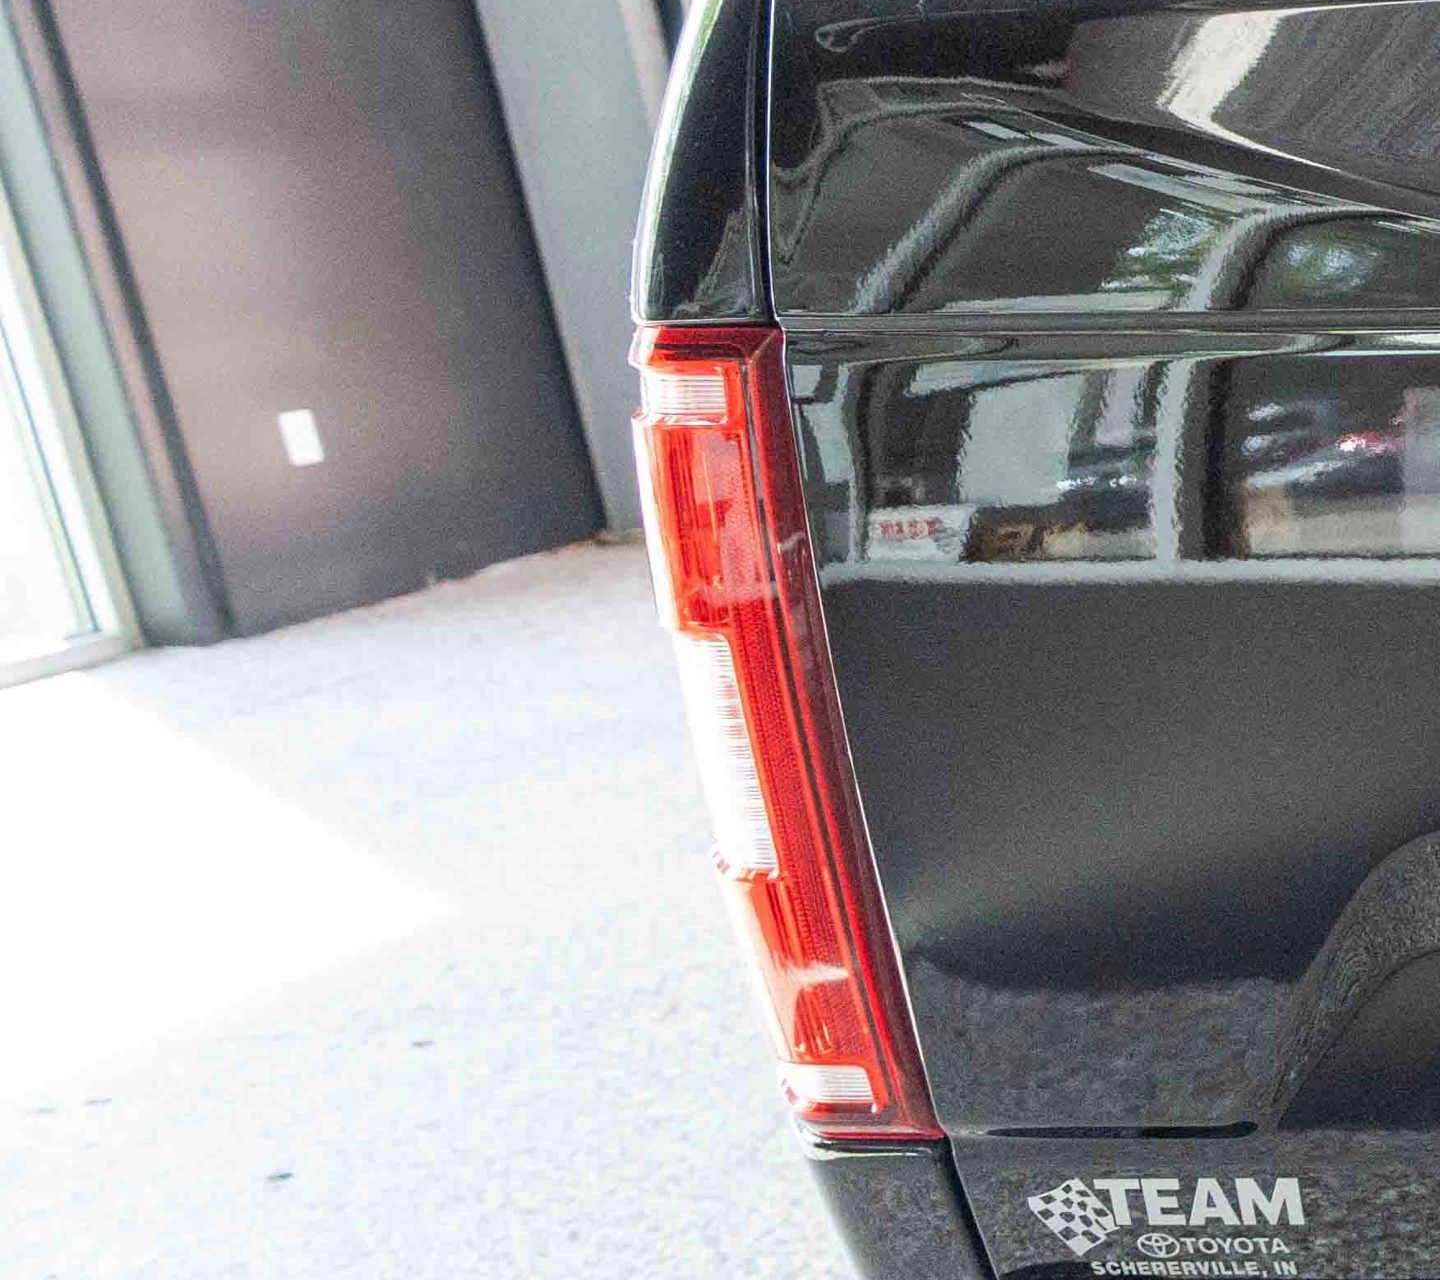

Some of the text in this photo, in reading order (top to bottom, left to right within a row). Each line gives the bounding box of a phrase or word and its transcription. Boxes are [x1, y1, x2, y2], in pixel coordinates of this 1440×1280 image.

[1093, 1177, 1306, 1226] TEAM
[1179, 1237, 1291, 1255] TOYOTA
[1090, 1260, 1299, 1278] SCHERERVILLE, IN
